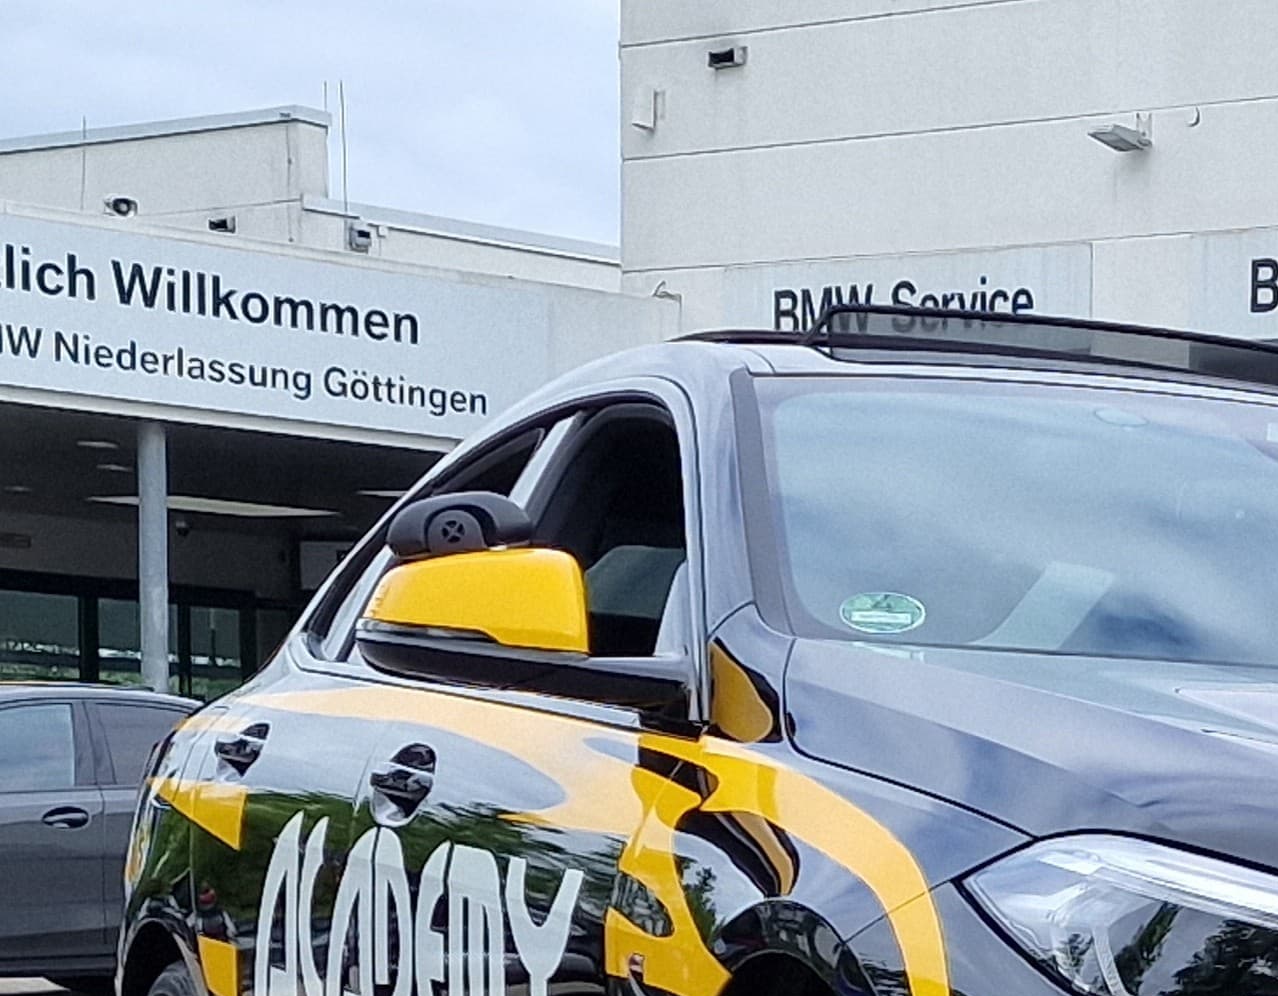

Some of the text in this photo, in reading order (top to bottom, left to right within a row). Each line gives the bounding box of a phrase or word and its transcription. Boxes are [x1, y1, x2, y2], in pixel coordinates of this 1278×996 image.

[0, 243, 420, 345] lich Willkommen
[773, 275, 1035, 333] BMW Service
[0, 322, 487, 417] W Niederlassung Göttingen
